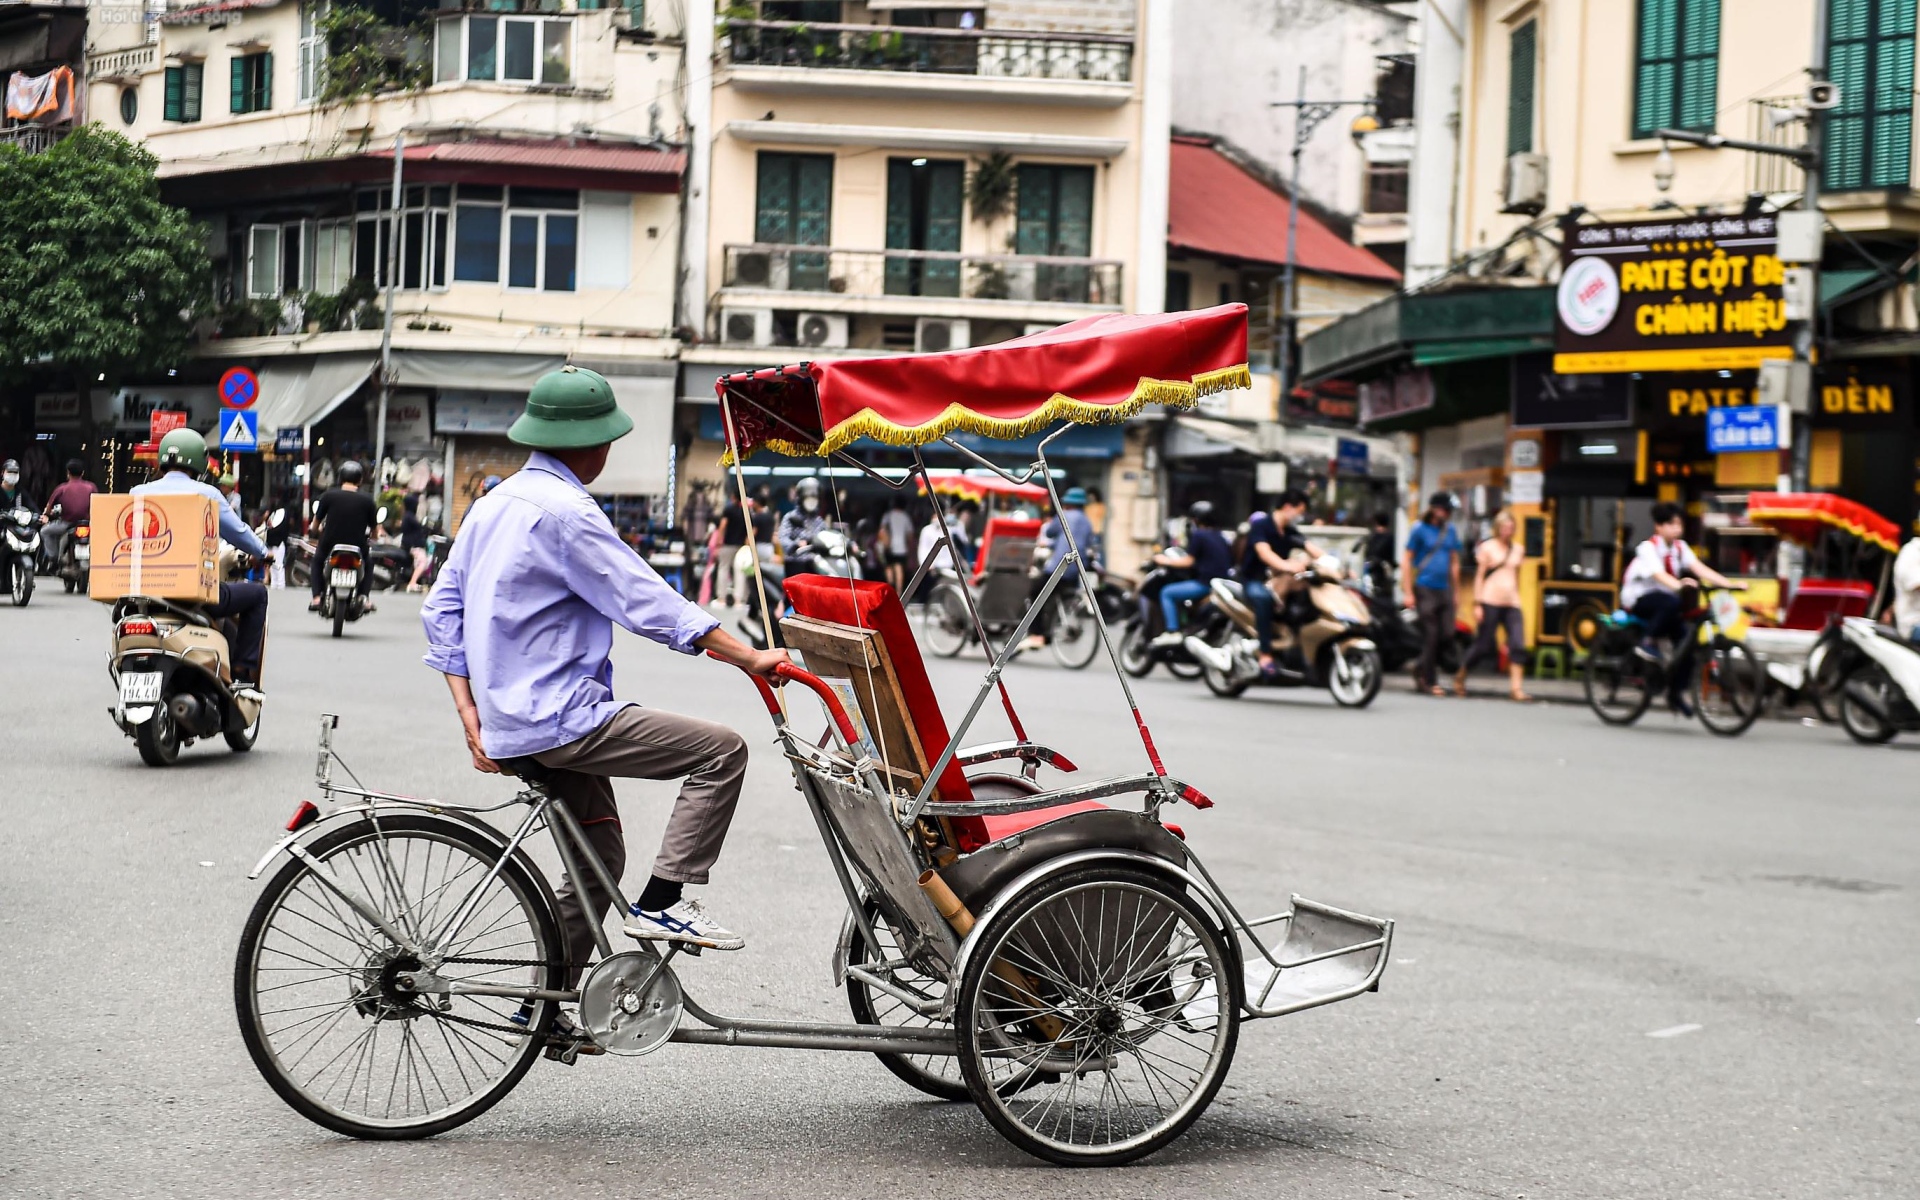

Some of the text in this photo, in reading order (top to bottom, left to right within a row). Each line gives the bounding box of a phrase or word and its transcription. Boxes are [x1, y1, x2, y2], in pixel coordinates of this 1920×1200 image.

[1621, 259, 1687, 292] PATE
[1690, 249, 1748, 296] CỘT
[1635, 292, 1786, 338] CHÍNH HIỆU
